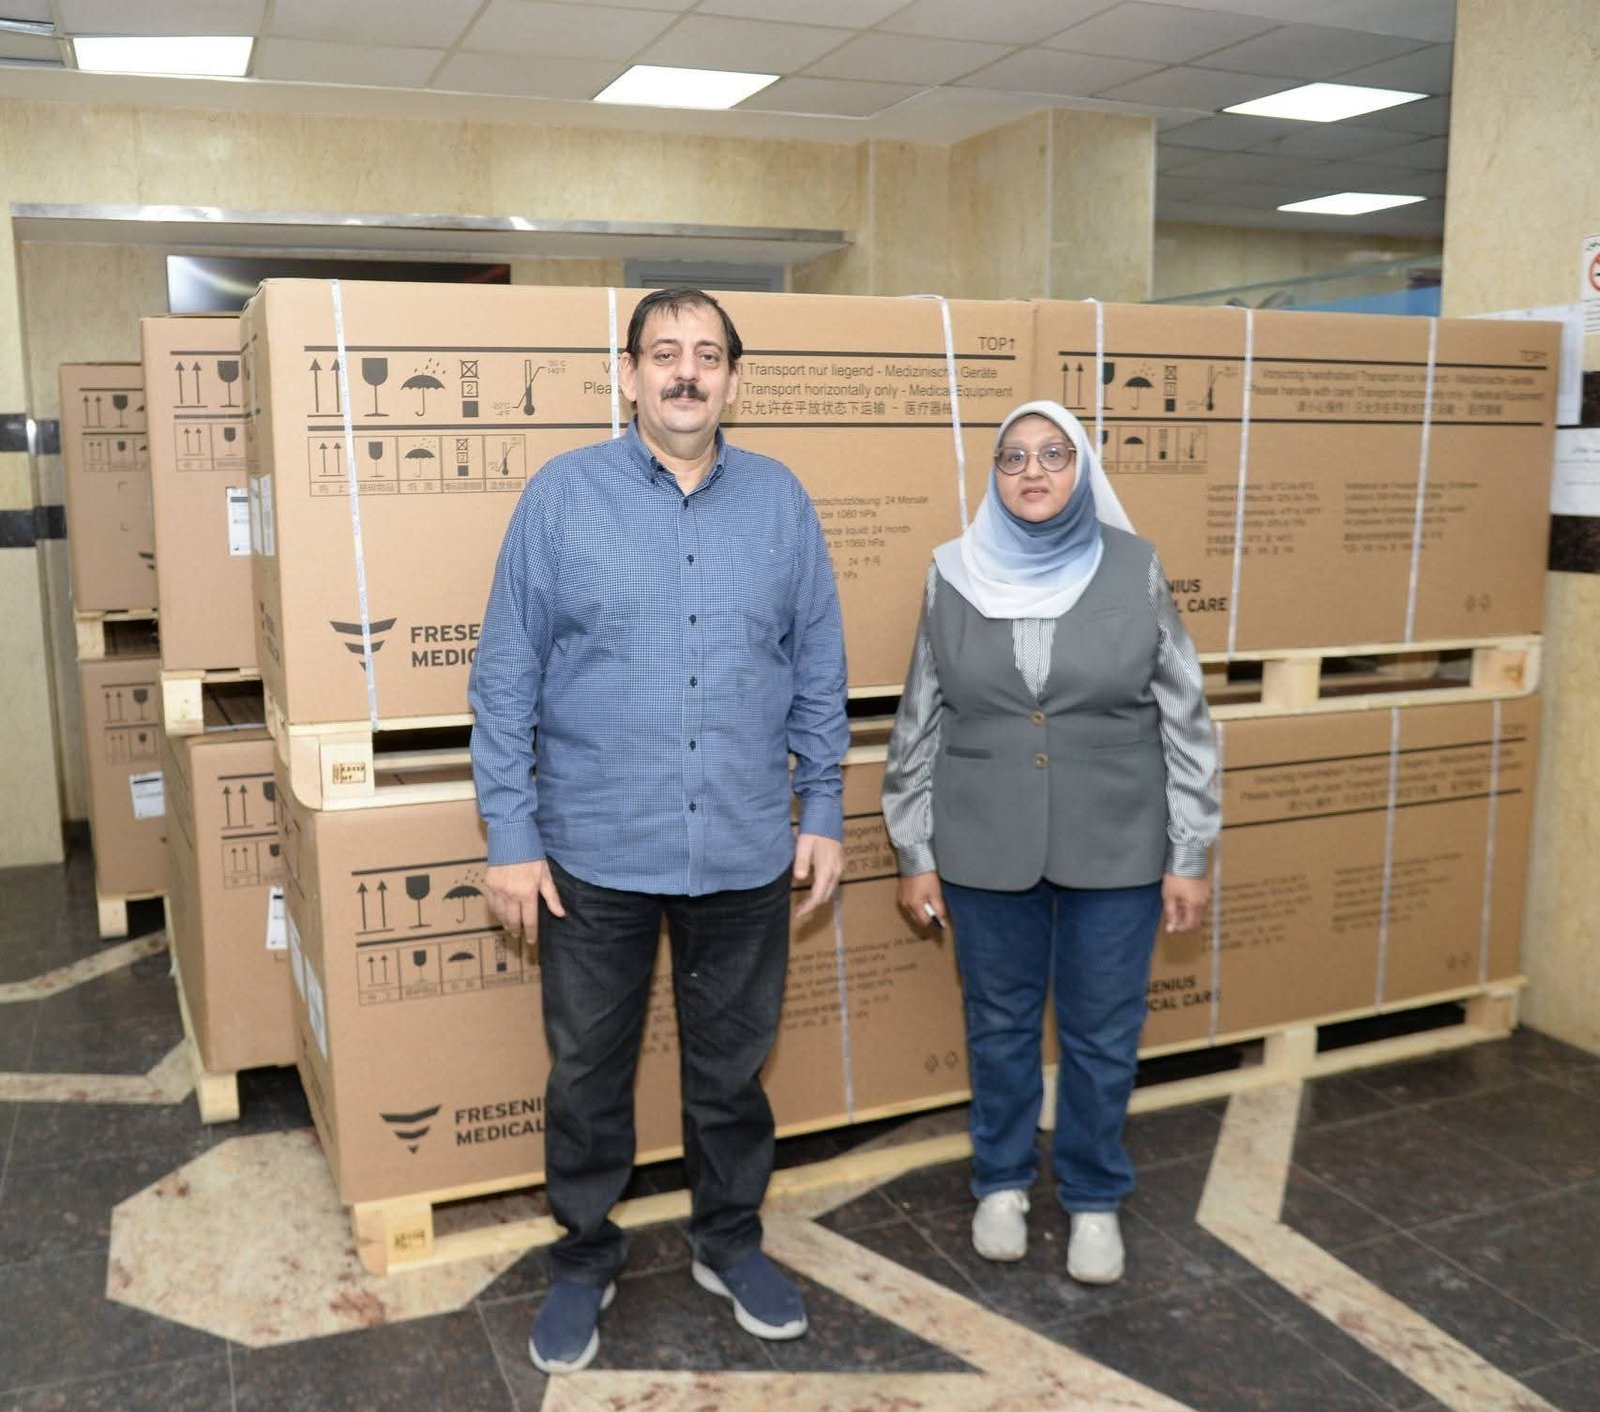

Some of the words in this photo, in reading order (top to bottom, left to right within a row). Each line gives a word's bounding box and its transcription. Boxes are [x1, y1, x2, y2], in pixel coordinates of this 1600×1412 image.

[747, 363, 805, 378] Transport
[809, 366, 829, 376] nur
[831, 364, 874, 380] liegend
[960, 366, 998, 379] Geräte
[743, 382, 801, 398] Transport
[805, 383, 871, 399] horizontally
[874, 384, 899, 400] only
[908, 384, 954, 397] Medica
[956, 385, 1013, 401] Equipment
[1187, 598, 1228, 612] CARE
[410, 624, 481, 644] FRESE
[411, 648, 476, 668] MEDIC
[1147, 975, 1197, 994] ENIUS
[454, 1096, 546, 1124] FRESENI
[456, 1118, 546, 1147] MEDICAL
